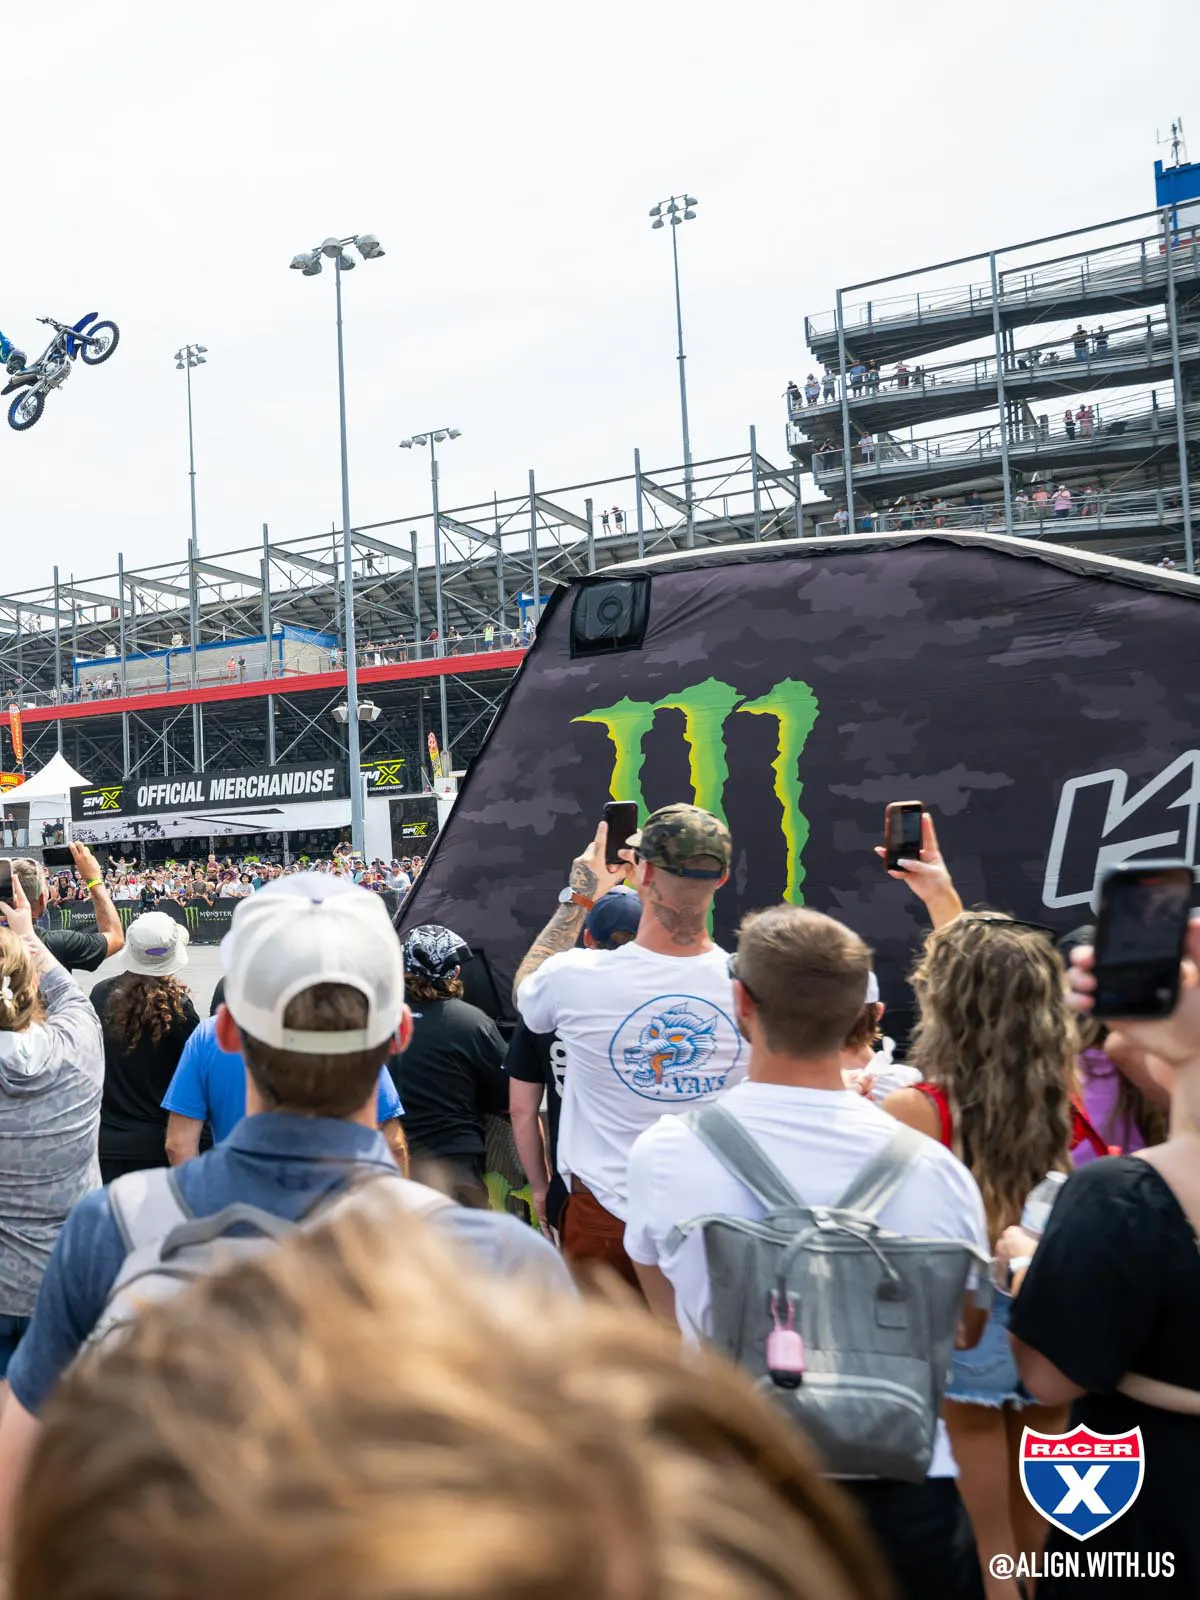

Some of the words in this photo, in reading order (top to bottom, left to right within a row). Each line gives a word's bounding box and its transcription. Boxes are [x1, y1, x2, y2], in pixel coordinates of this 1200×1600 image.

[137, 780, 205, 808] OFFICIAL
[209, 768, 335, 801] MERCHANDISE
[82, 790, 121, 810] SMX
[71, 912, 96, 920] MONSTE
[199, 909, 233, 918] MONSTER
[672, 1075, 729, 1094] VANS
